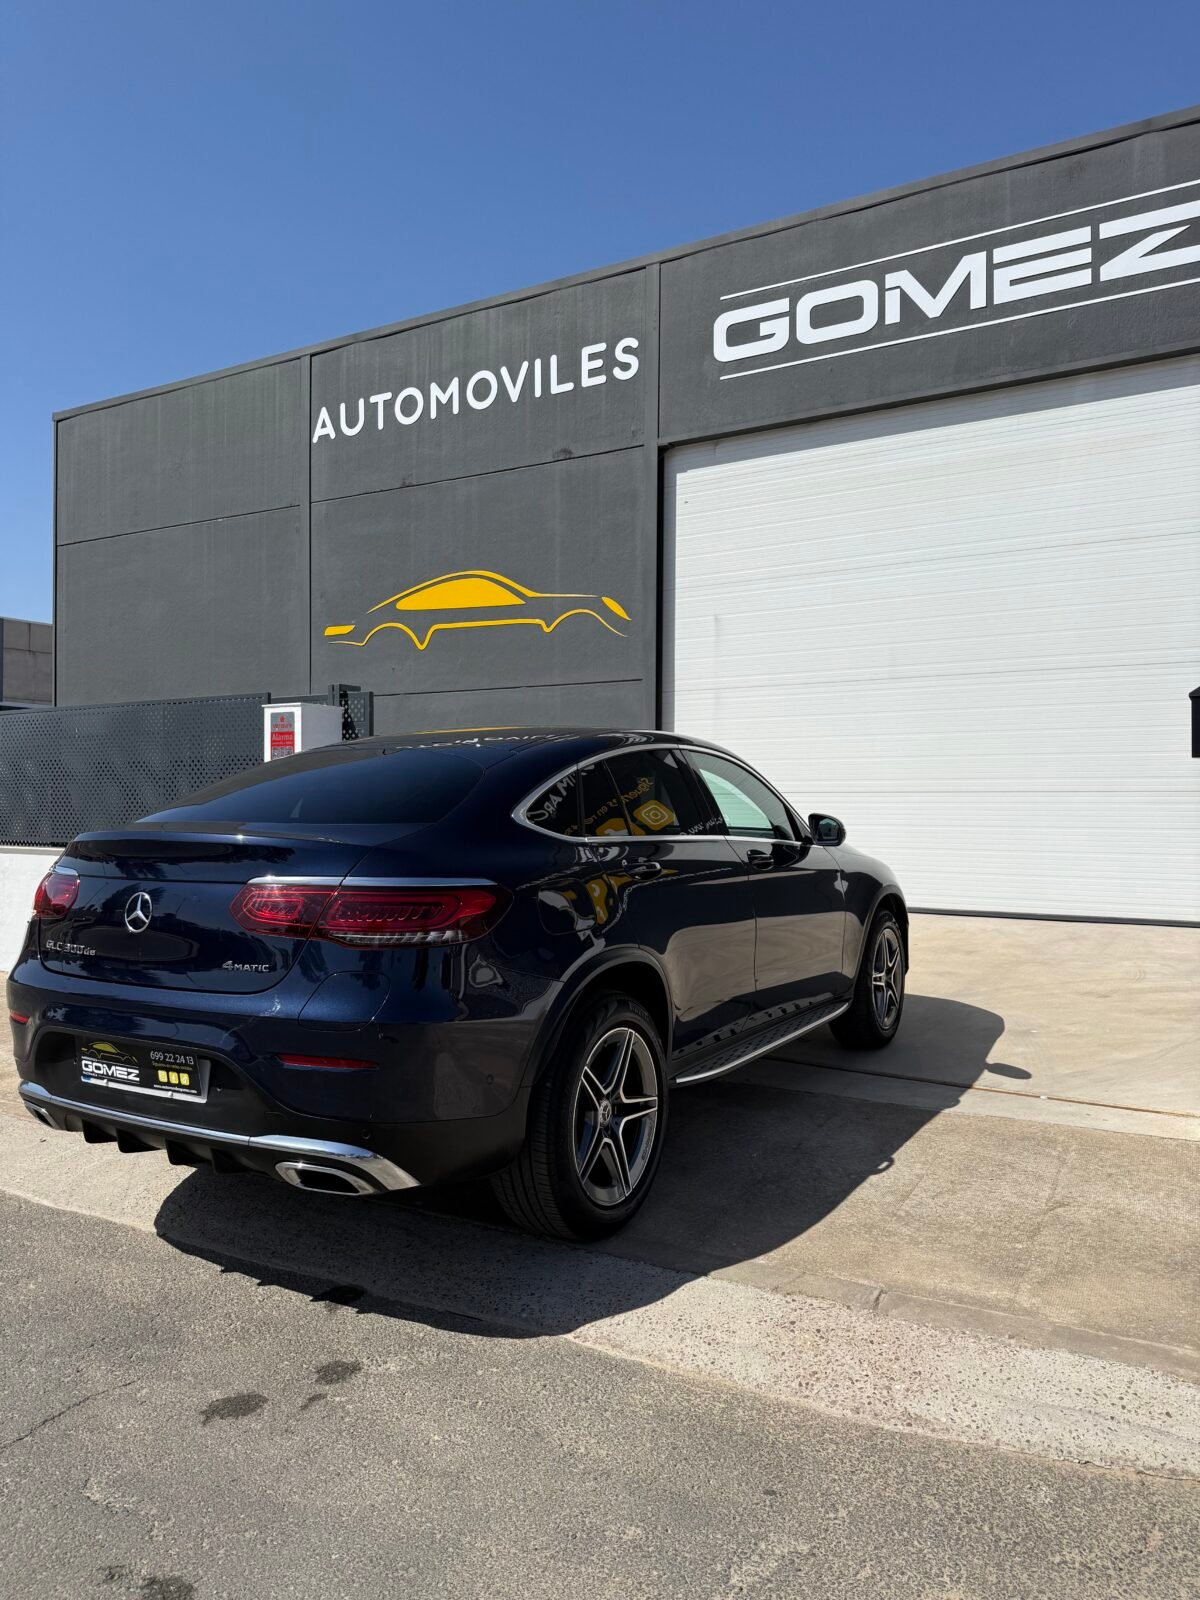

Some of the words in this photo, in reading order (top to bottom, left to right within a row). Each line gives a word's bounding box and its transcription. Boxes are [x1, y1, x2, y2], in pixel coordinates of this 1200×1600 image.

[713, 199, 1200, 362] GOMEZ
[312, 337, 640, 443] AUTOMOVILES
[222, 960, 270, 972] 4MATIC
[150, 1050, 164, 1062] 699
[165, 1053, 176, 1063] 22
[176, 1054, 186, 1064] 24
[186, 1055, 195, 1065] 13
[81, 1059, 140, 1081] GOMEZ
